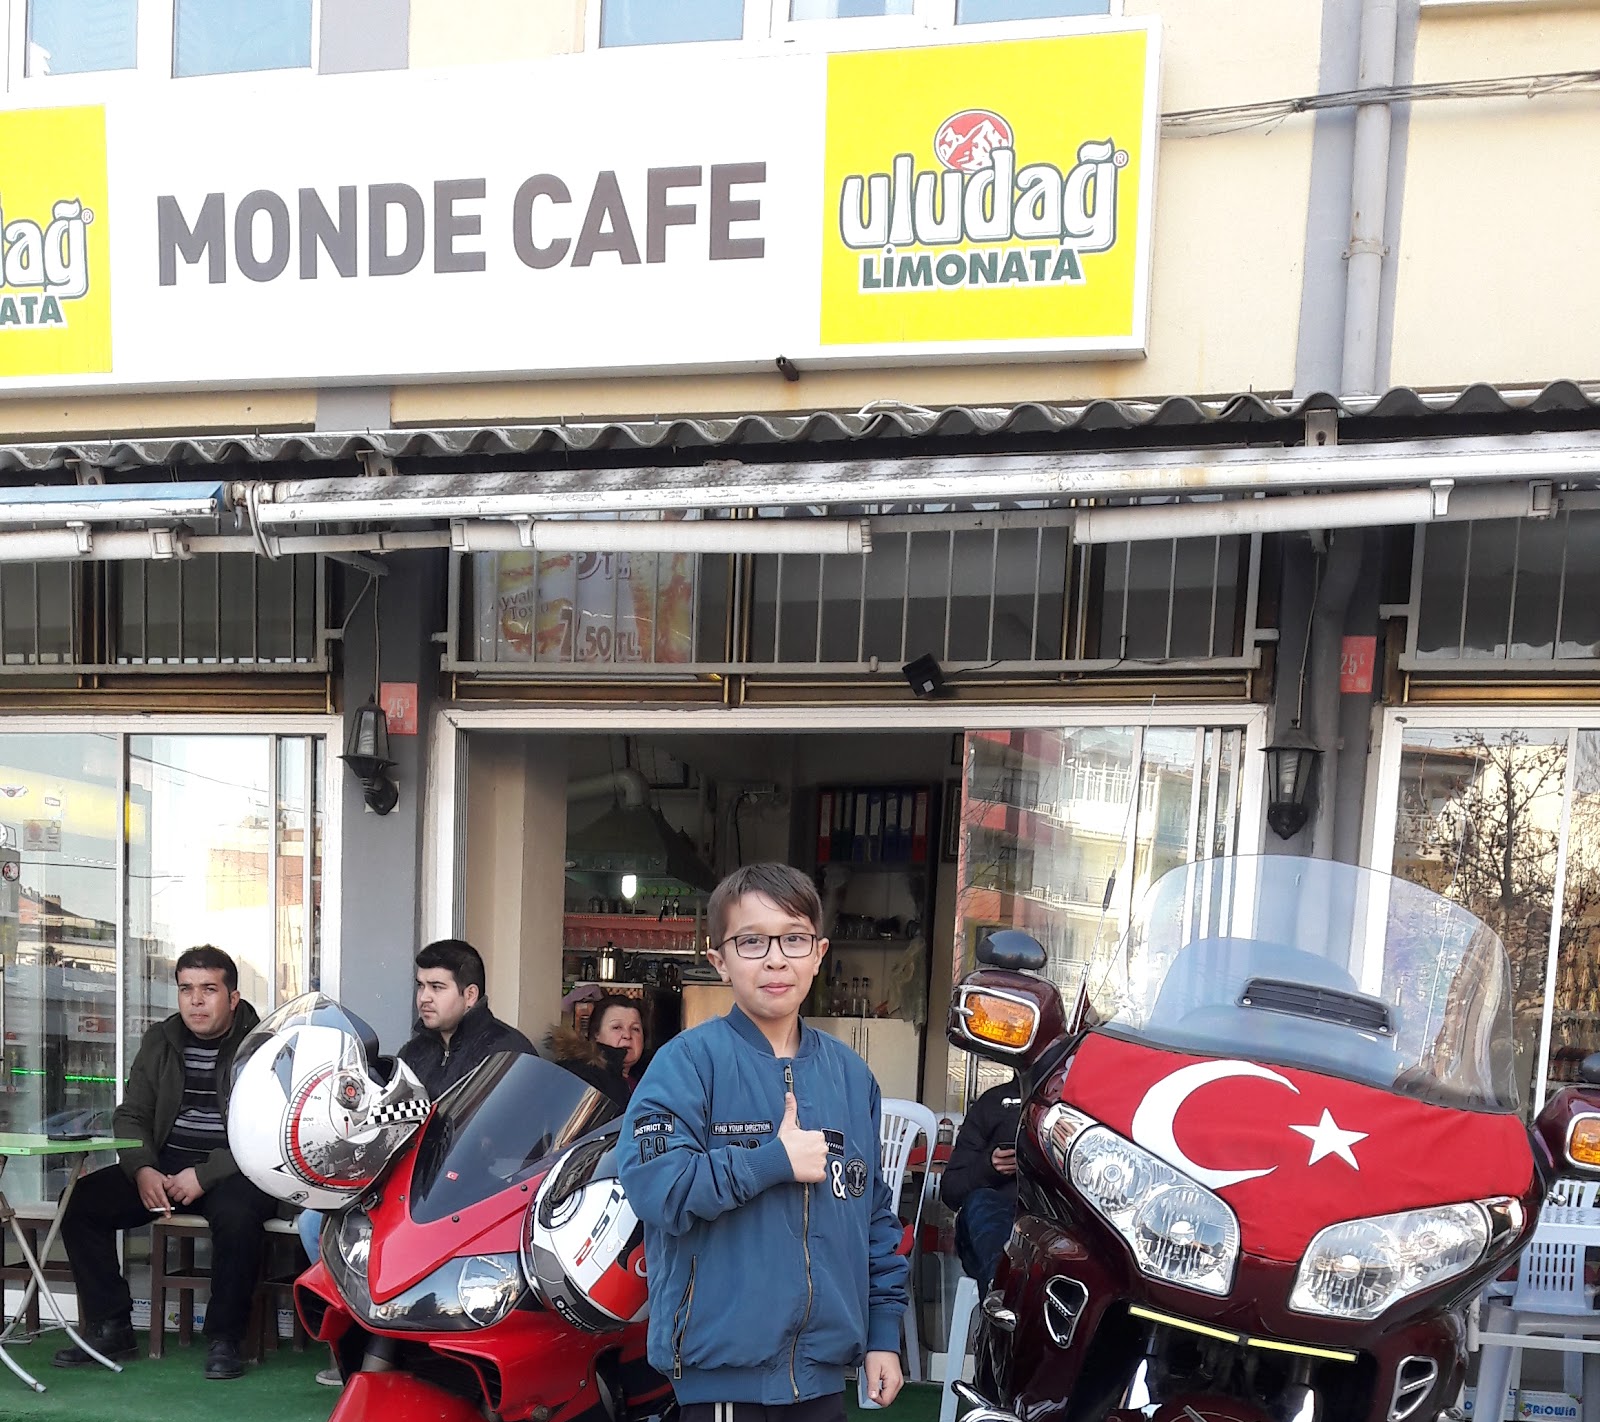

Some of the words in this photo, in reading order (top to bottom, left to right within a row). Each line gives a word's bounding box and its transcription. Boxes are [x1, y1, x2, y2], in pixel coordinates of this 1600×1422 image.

[0, 197, 89, 300] ağ
[156, 177, 487, 287] MONDE
[512, 161, 767, 270] CAFE
[839, 137, 1118, 253] uludağ
